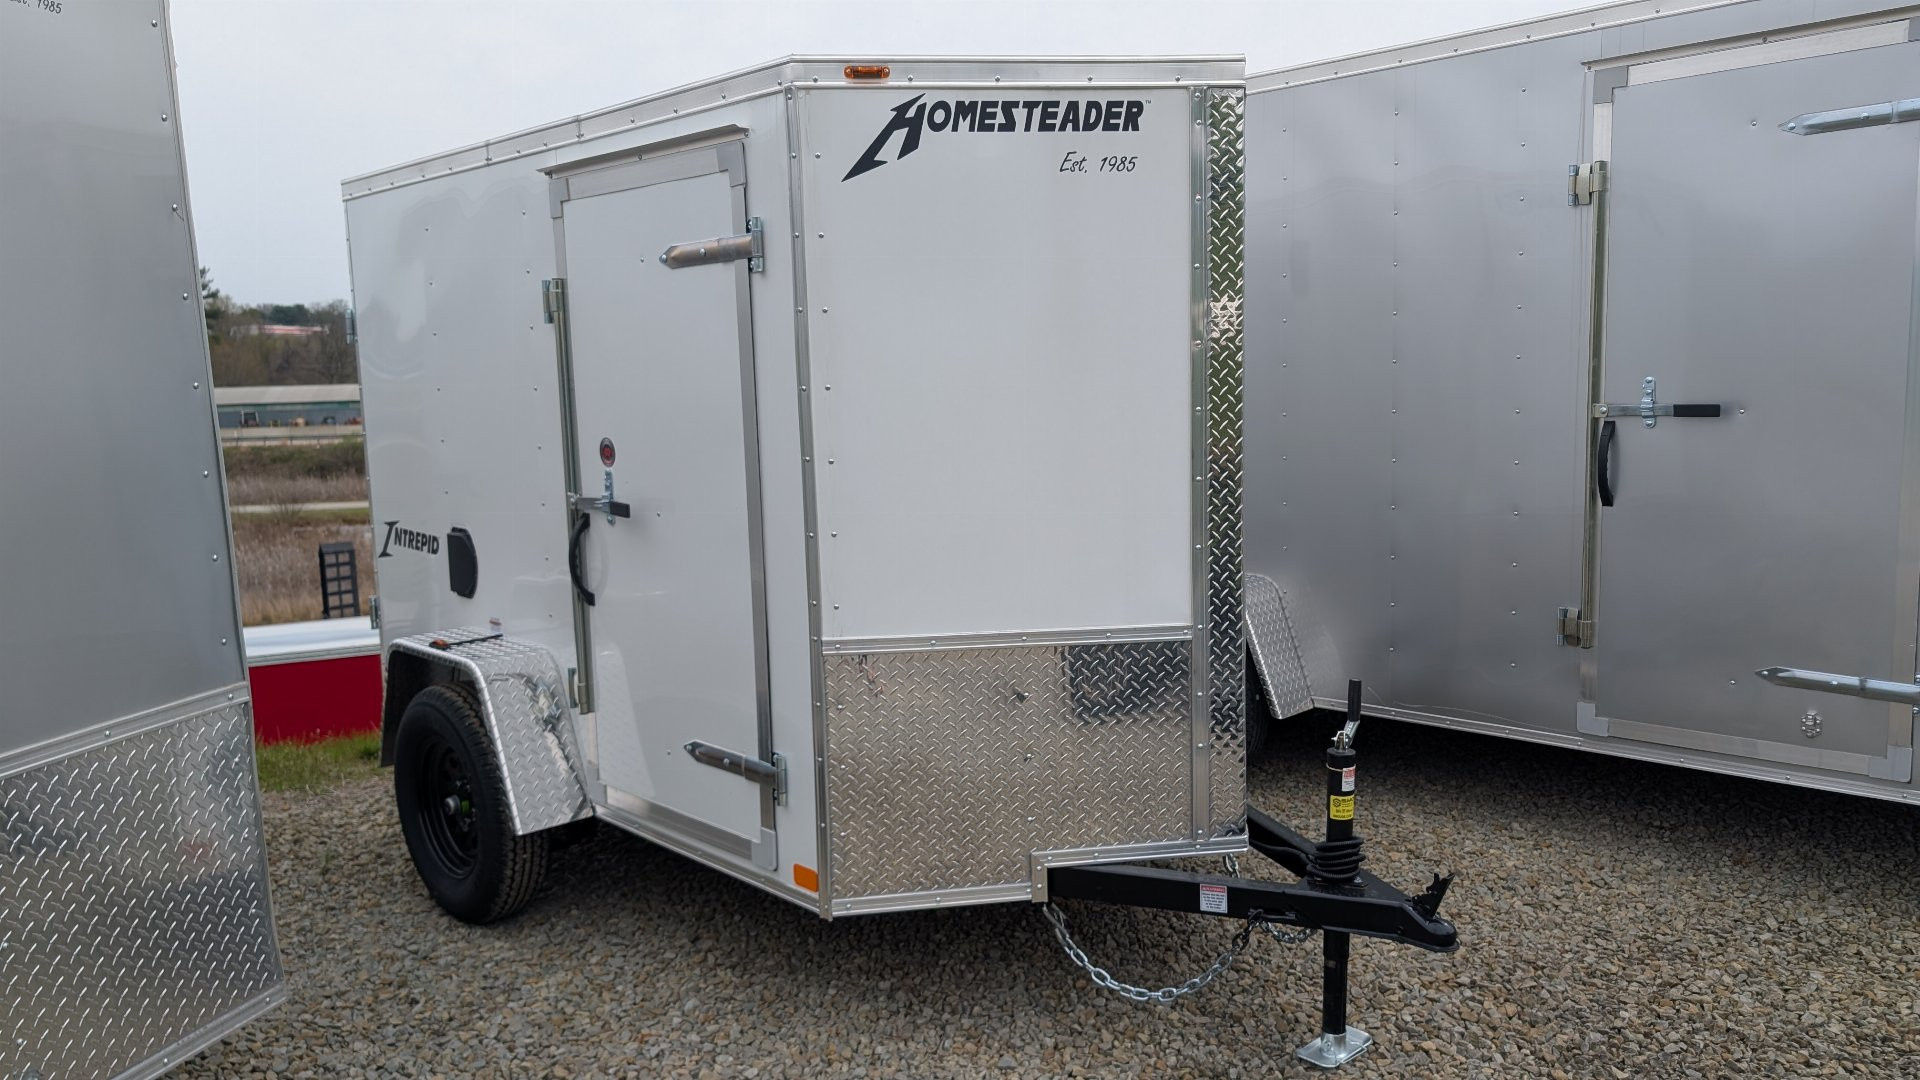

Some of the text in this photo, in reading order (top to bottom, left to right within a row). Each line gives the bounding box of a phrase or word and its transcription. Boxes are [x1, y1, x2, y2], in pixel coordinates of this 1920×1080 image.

[841, 93, 1144, 182] HOMESTEADER
[1100, 155, 1138, 172] 1985
[378, 520, 440, 558] INTREPID
